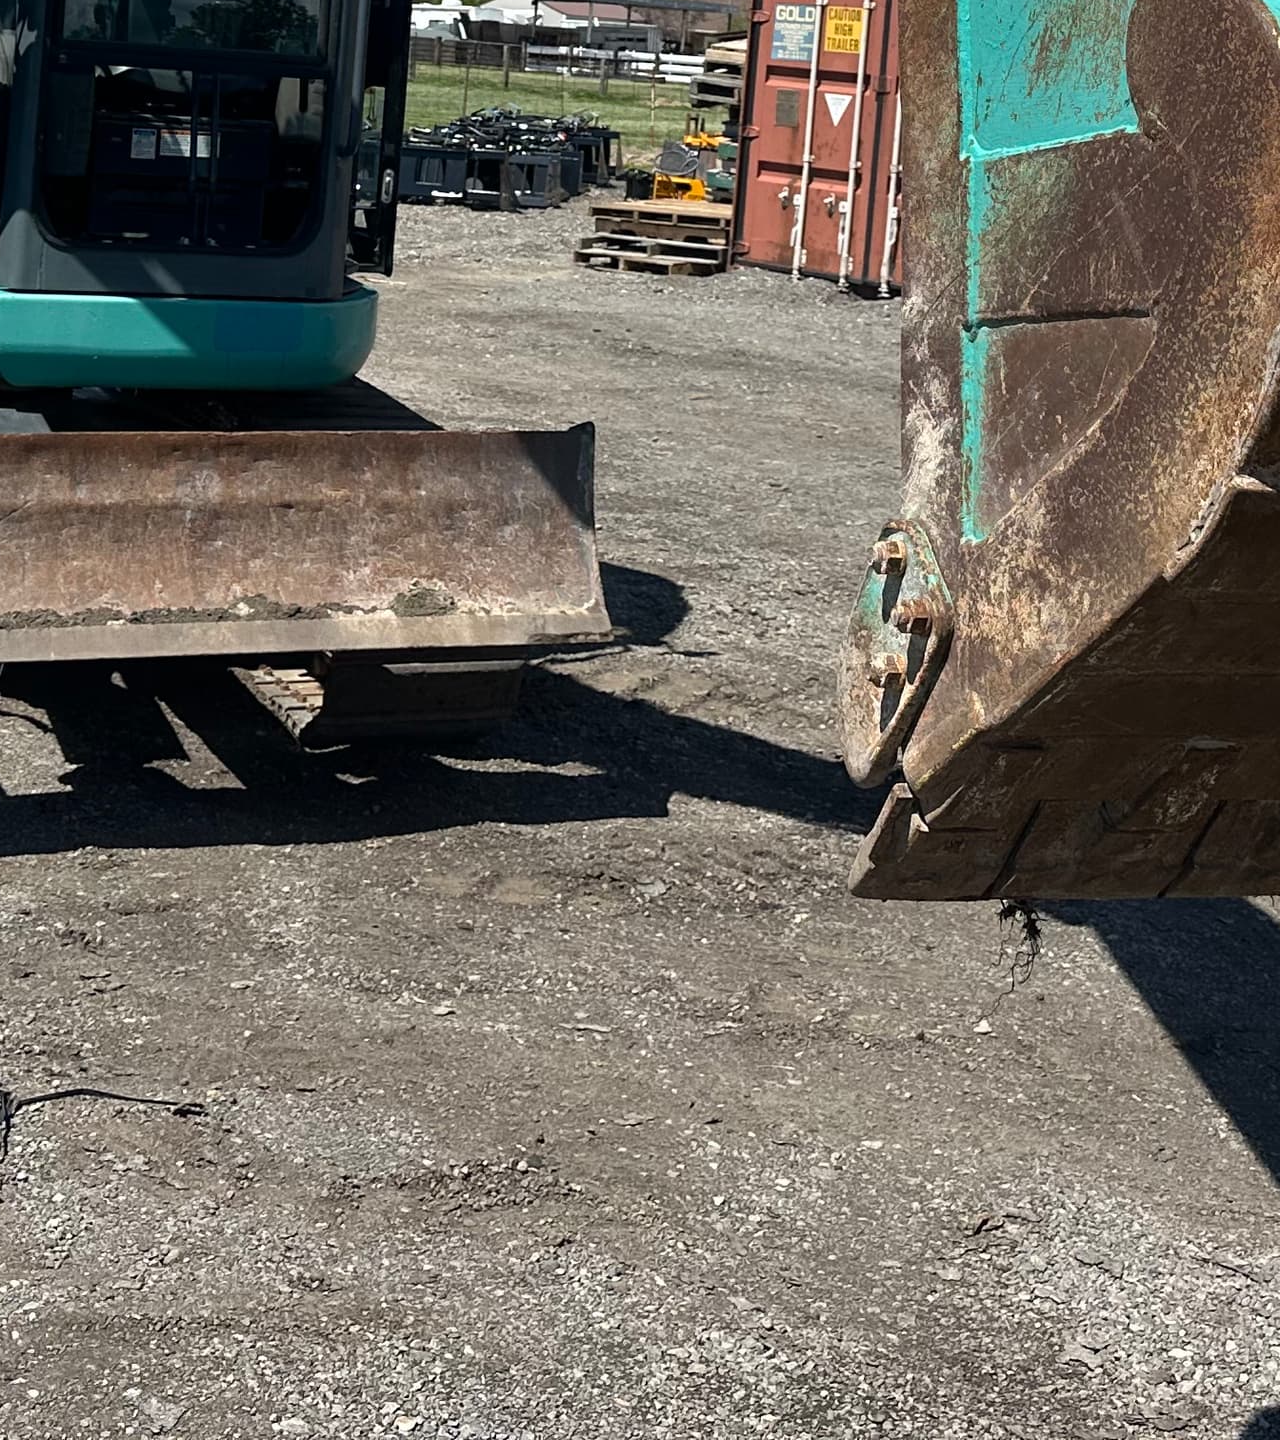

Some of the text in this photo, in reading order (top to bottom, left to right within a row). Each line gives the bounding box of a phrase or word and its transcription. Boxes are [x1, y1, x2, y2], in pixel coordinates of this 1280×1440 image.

[776, 5, 816, 22] GOLD
[828, 7, 862, 22] CAUTION
[834, 23, 854, 37] HIGH
[826, 37, 860, 52] TRAILER
